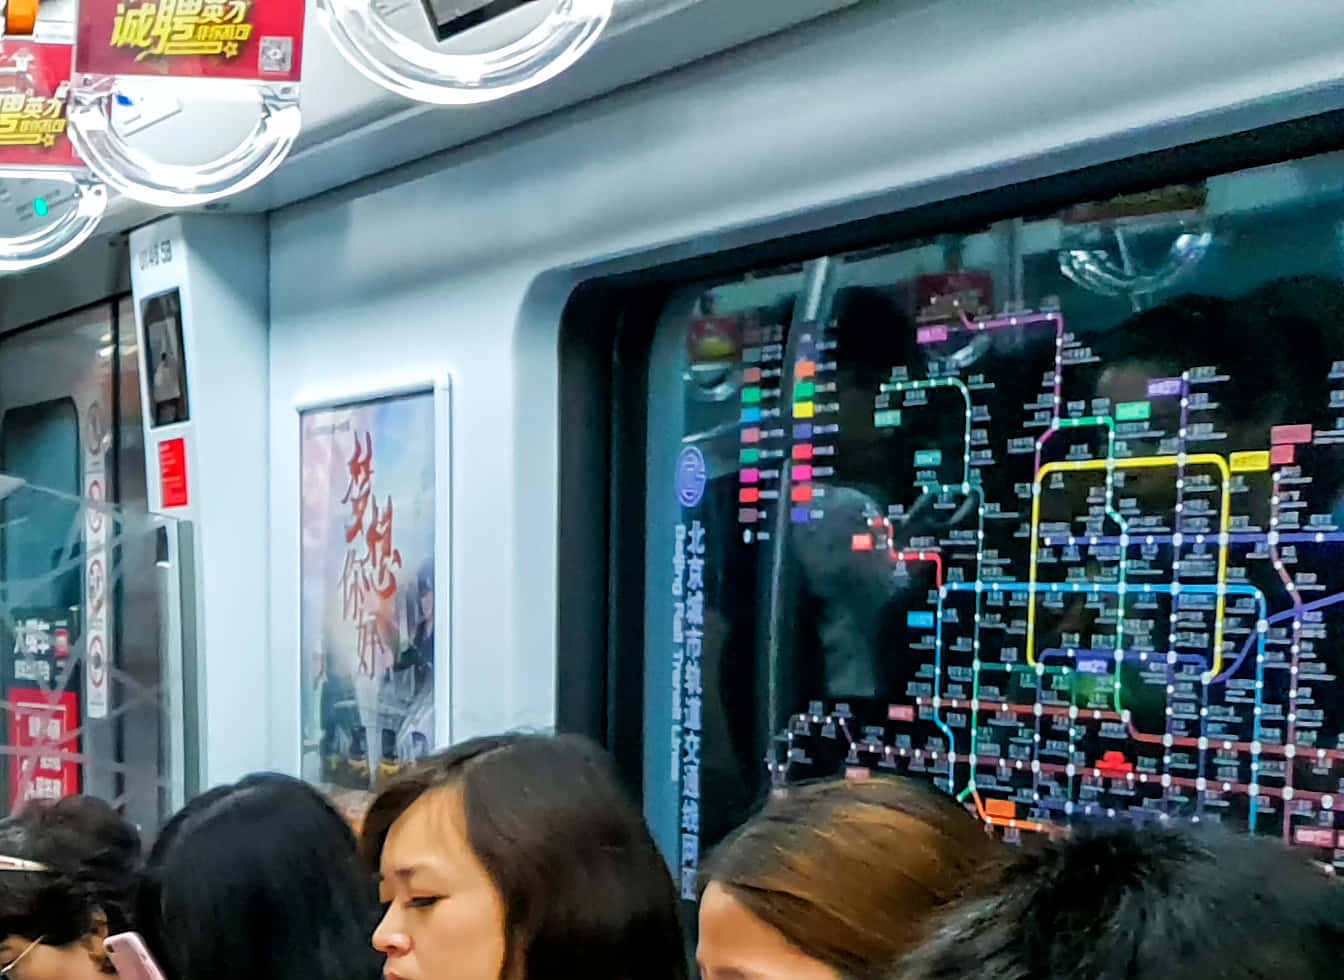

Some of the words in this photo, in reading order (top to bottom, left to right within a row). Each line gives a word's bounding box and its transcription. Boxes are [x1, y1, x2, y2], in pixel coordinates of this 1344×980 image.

[23, 96, 63, 119] 英才
[671, 524, 687, 596] Beijing
[672, 602, 685, 643] Rail
[671, 648, 684, 720] Transit
[670, 725, 682, 782] Lines
